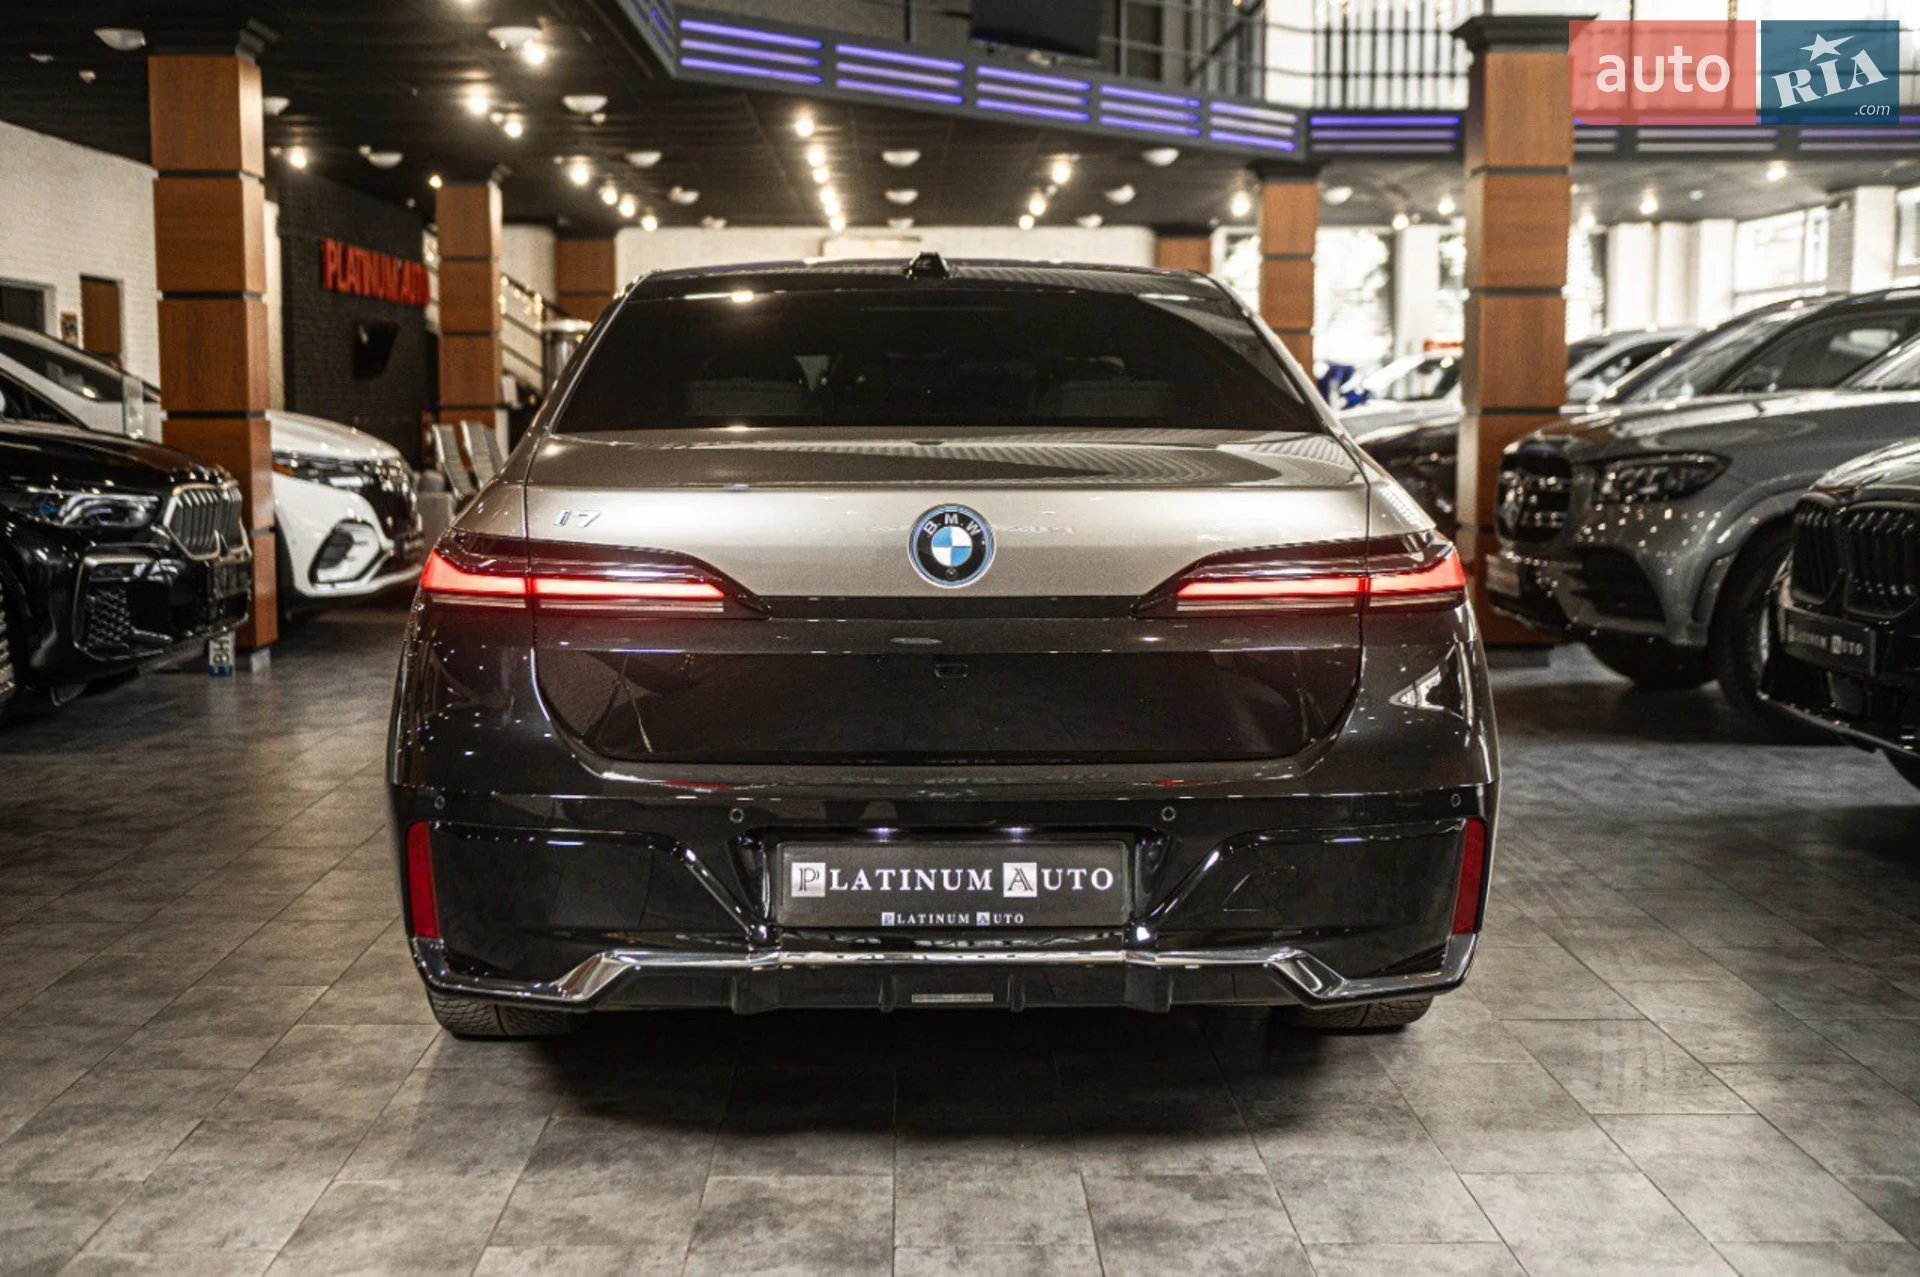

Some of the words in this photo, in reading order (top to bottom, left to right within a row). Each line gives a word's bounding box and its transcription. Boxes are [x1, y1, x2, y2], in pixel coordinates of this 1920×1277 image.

[923, 512, 982, 537] BMW
[793, 863, 993, 896] PLATINUM
[1004, 863, 1114, 896] AUTO
